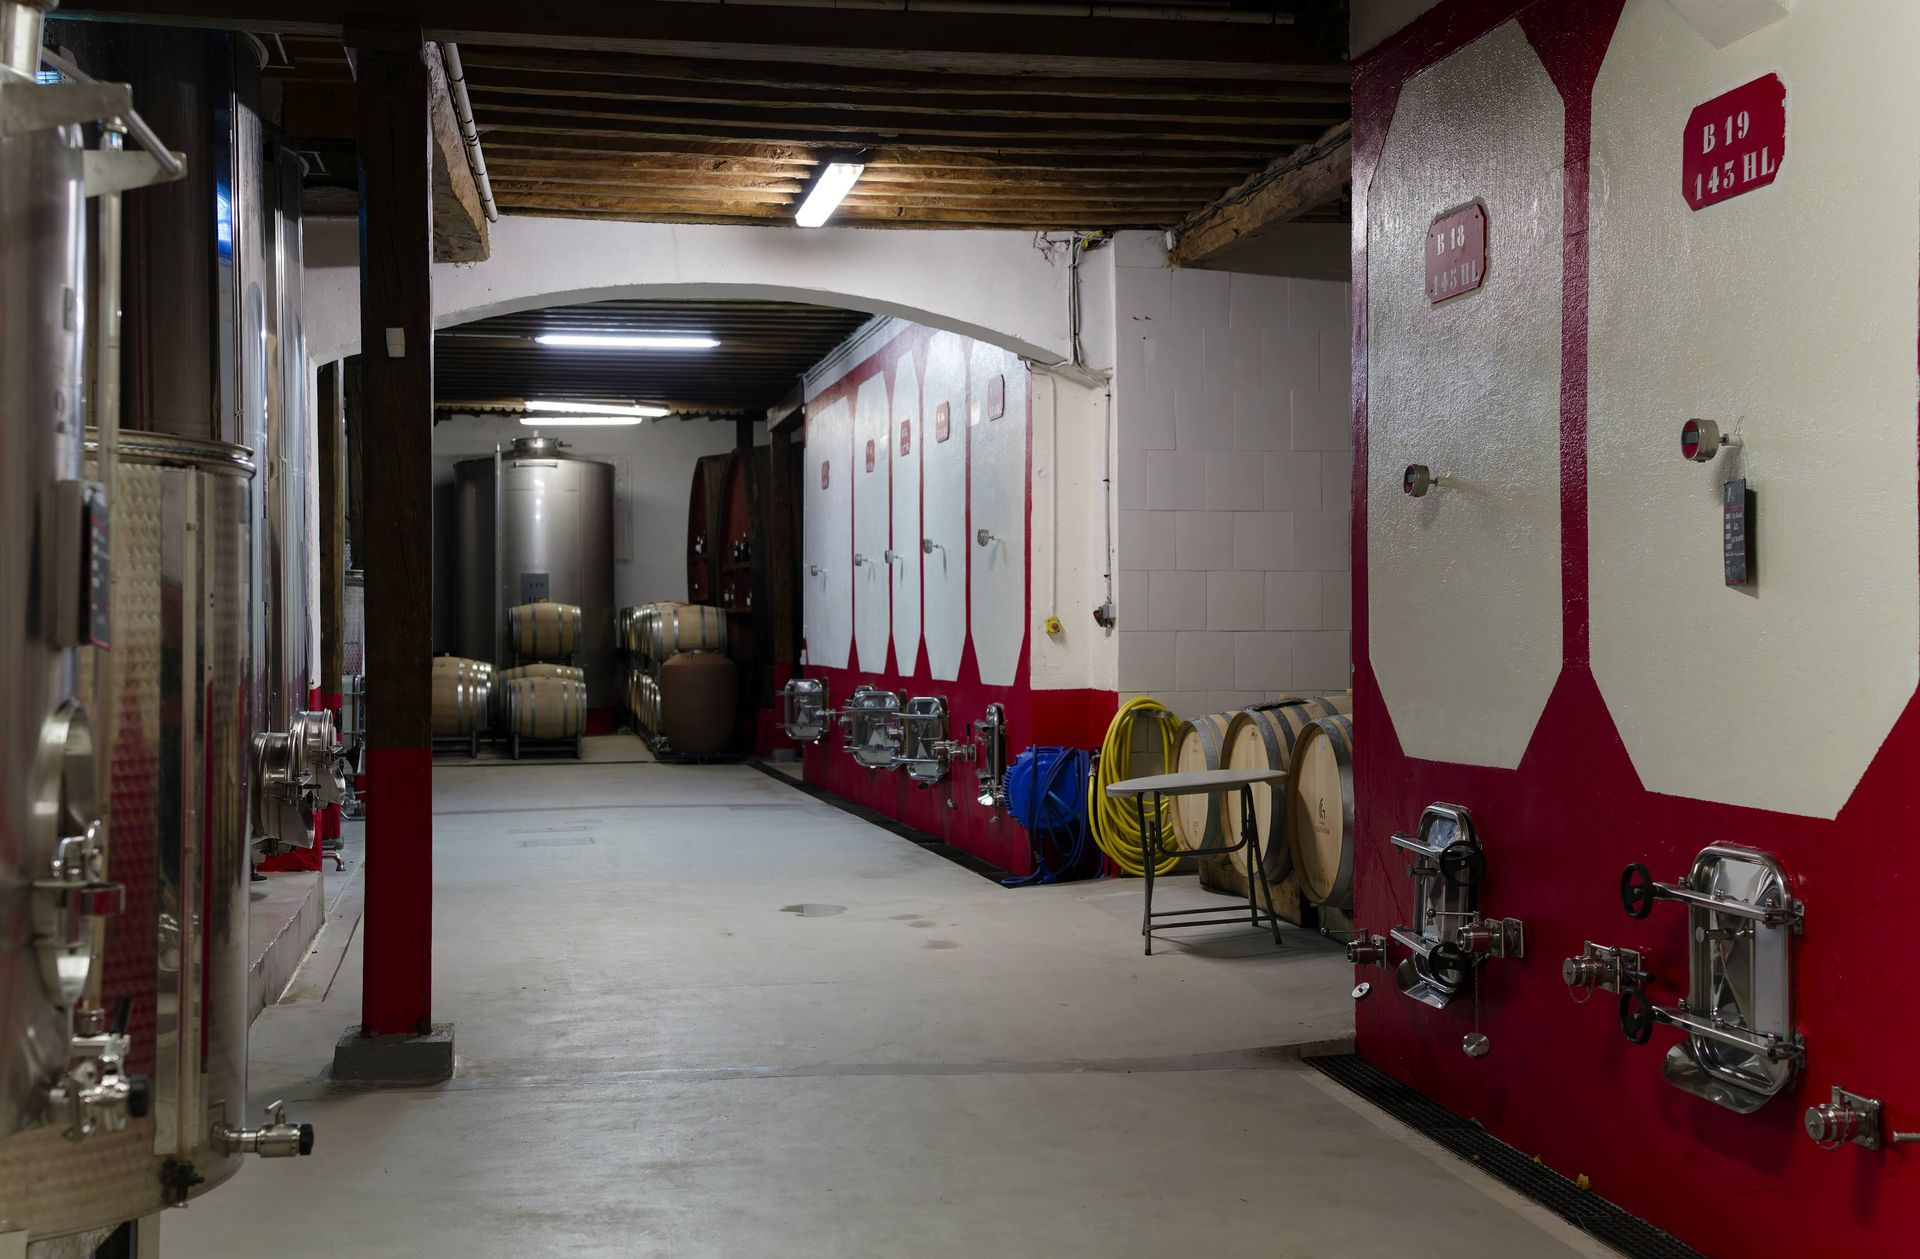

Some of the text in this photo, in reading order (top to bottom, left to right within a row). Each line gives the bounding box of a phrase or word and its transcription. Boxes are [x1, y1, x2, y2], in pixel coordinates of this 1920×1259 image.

[1702, 110, 1750, 154] B 19
[1694, 146, 1775, 201] 145 HL
[1437, 224, 1465, 256] B 18
[1433, 259, 1480, 296] 145 HL
